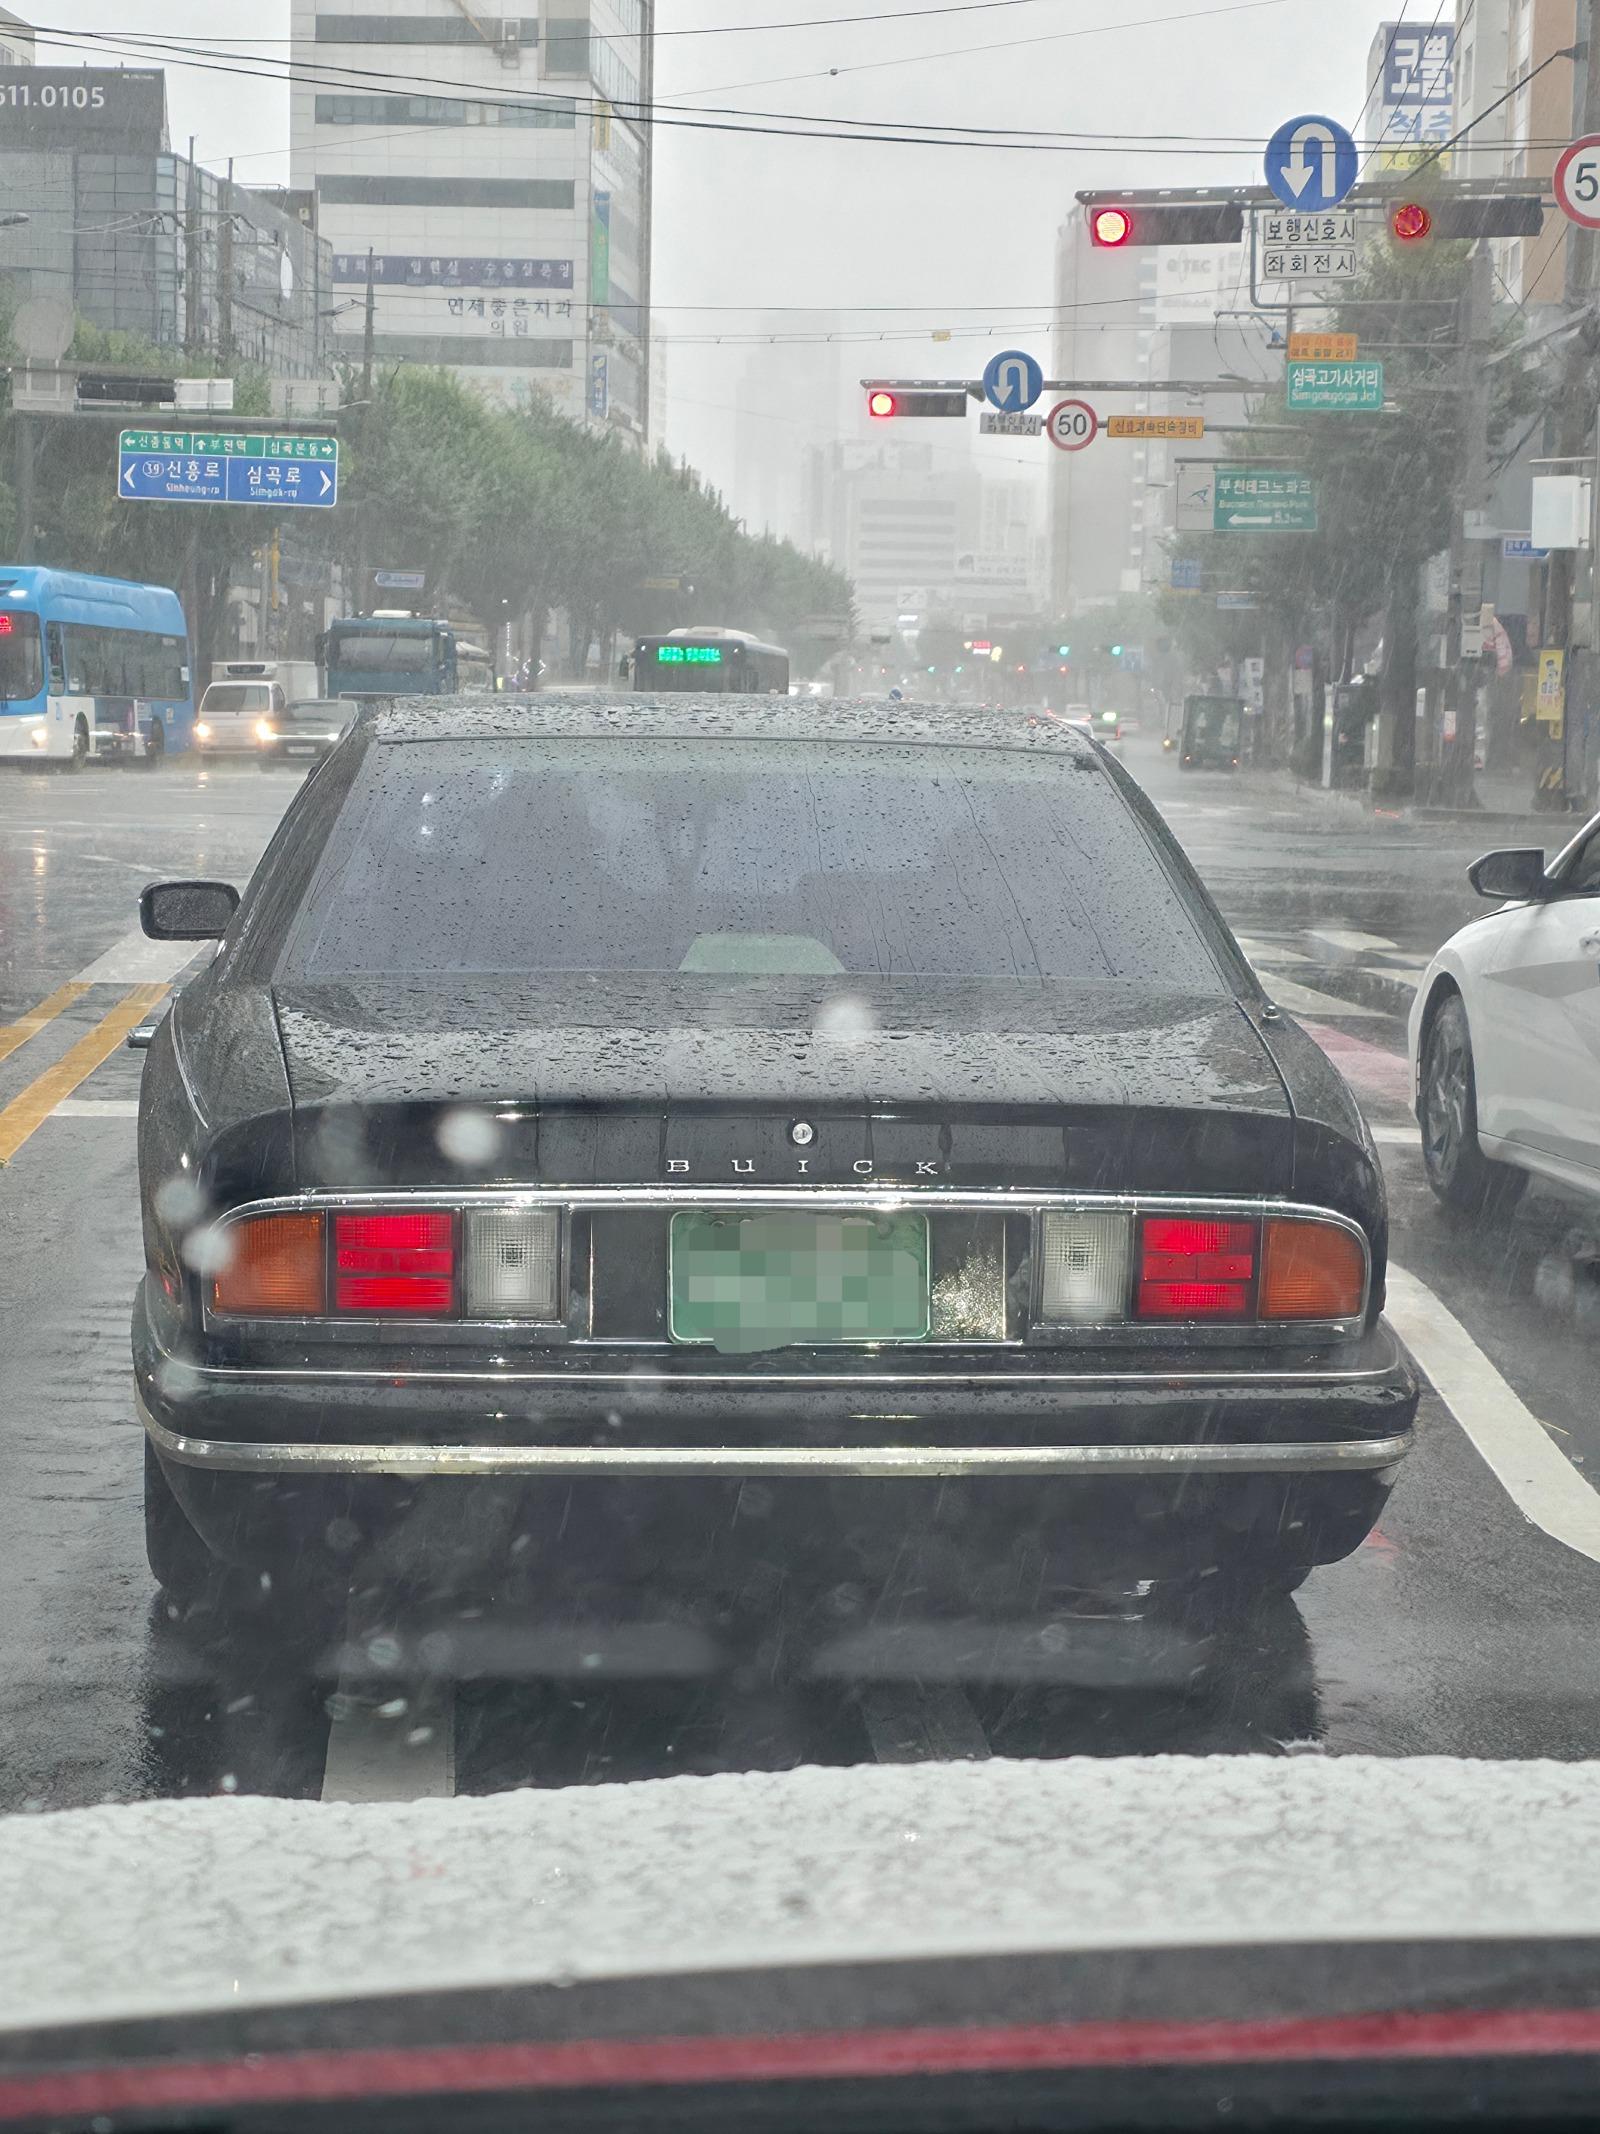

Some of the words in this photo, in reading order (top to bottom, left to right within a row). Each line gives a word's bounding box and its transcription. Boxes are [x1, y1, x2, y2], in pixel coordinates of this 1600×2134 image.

[1391, 35, 1454, 98] 코뿔
[1267, 218, 1355, 242] 보행신호시
[1267, 254, 1354, 274] 좌회전시
[489, 319, 528, 336] 의원
[1058, 414, 1087, 436] 50
[167, 461, 220, 482] 신흥로
[247, 465, 302, 485] 심곡로
[1218, 479, 1312, 495] 부천테크노파크
[667, 1159, 938, 1175] BUICK
